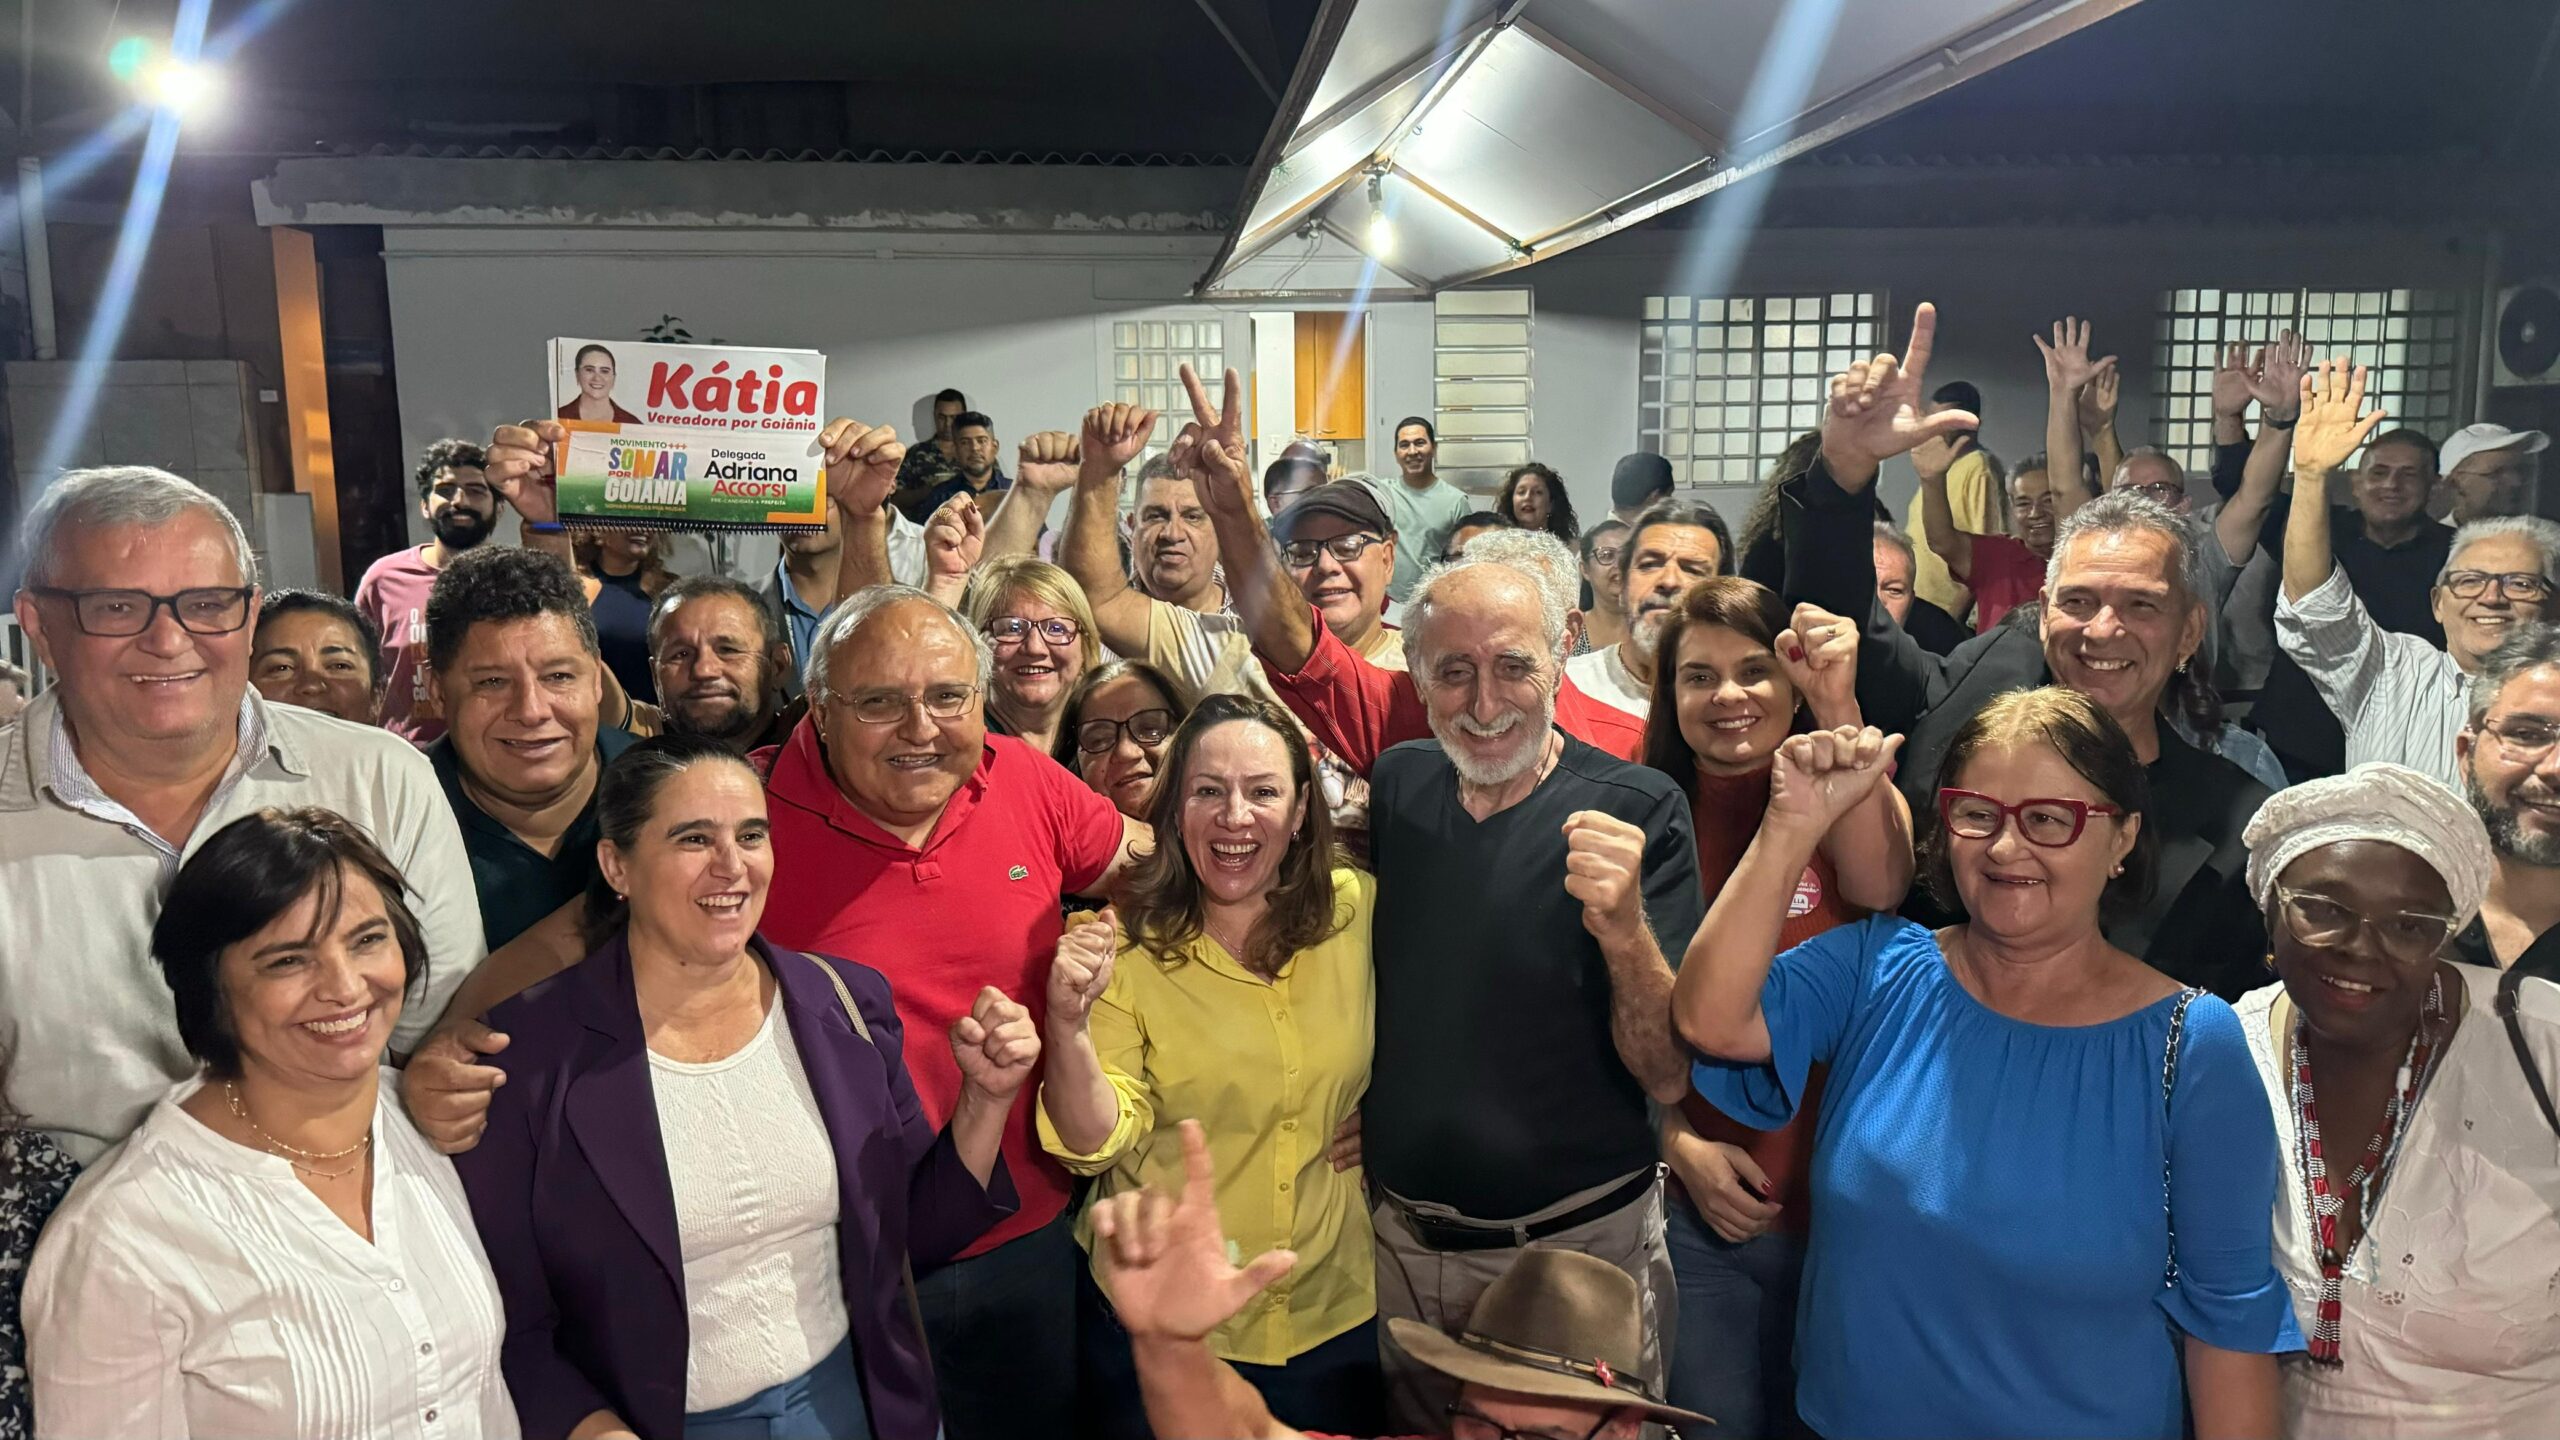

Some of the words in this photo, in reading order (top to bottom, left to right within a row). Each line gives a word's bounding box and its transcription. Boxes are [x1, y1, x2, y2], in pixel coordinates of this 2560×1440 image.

[647, 360, 818, 416] Kátia
[647, 412, 727, 428] Vereadora
[731, 418, 757, 431] por
[761, 418, 816, 431] Goiânia
[608, 447, 687, 481] SOMAR
[711, 448, 765, 461] Delegada
[608, 470, 632, 478] POR
[704, 460, 797, 482] Adriana
